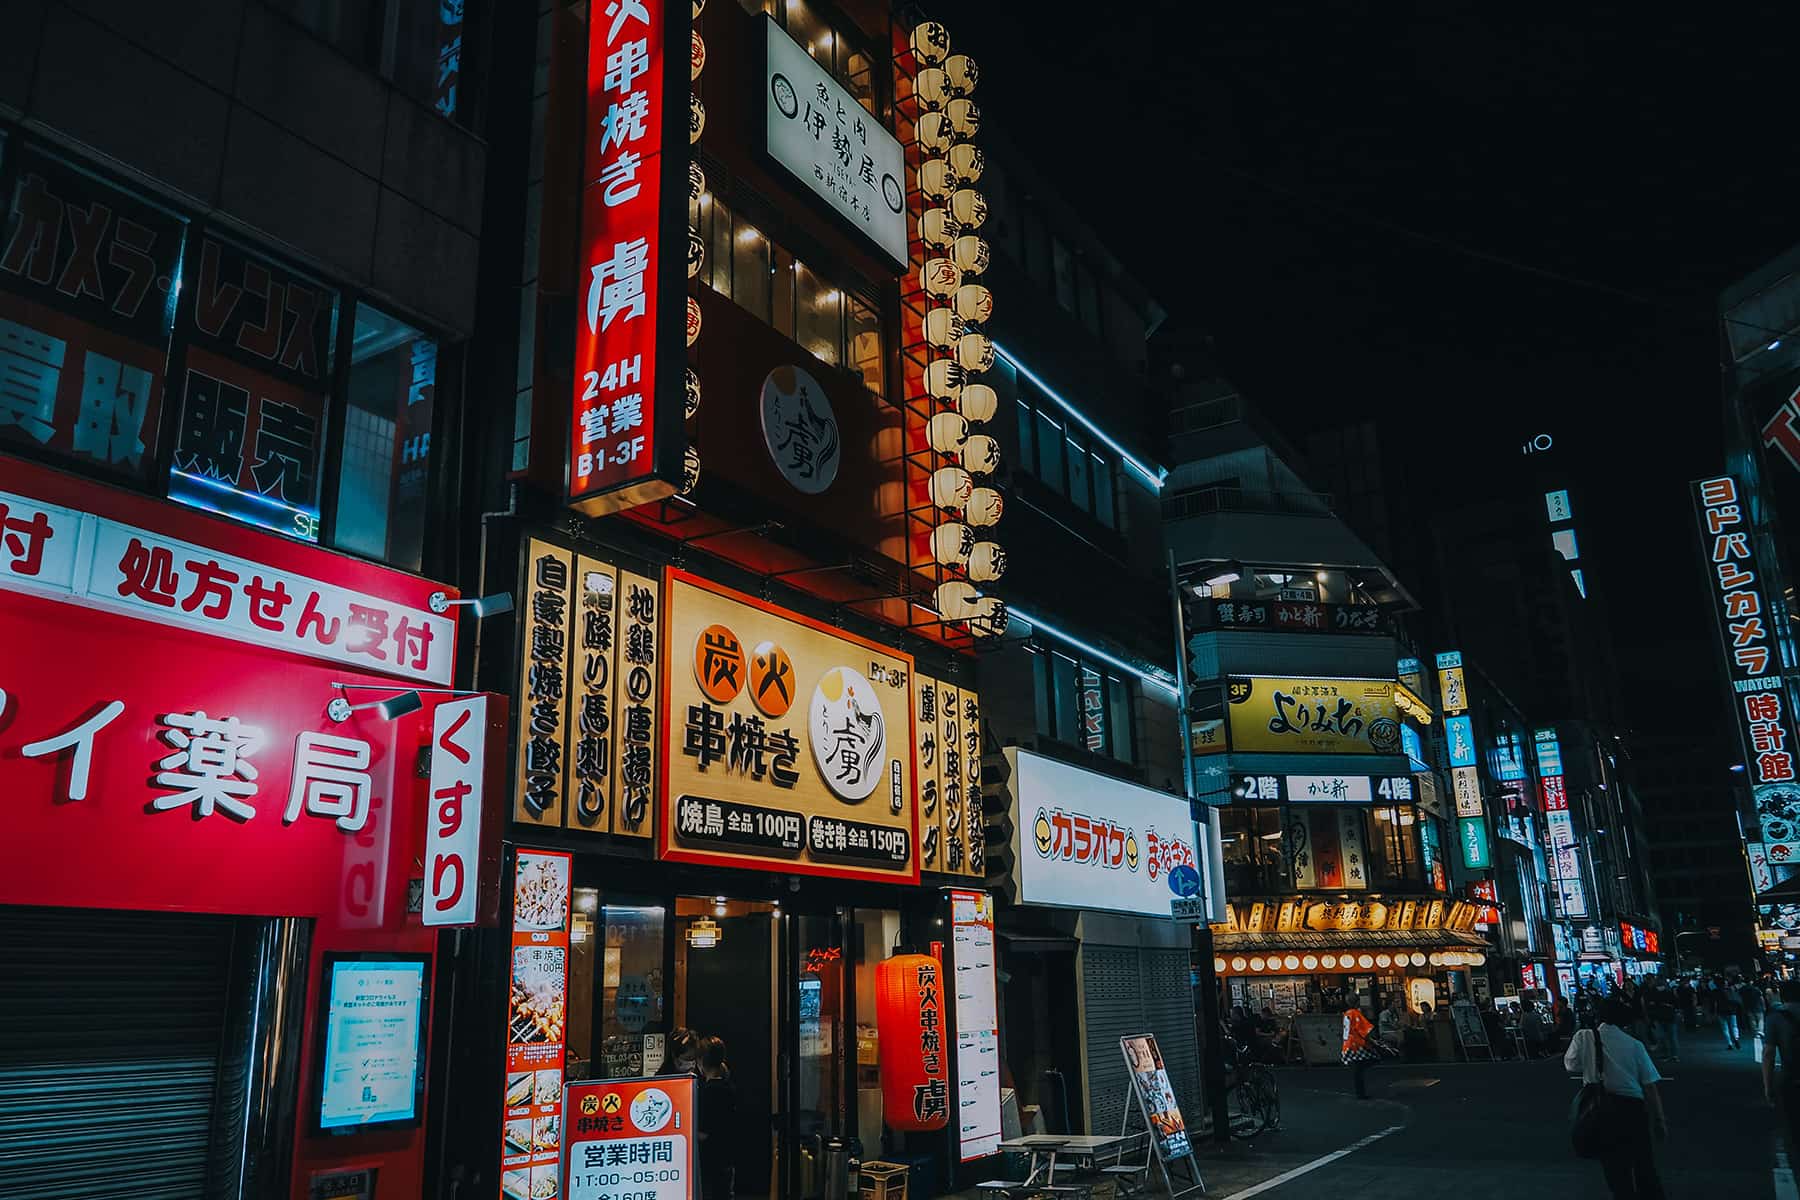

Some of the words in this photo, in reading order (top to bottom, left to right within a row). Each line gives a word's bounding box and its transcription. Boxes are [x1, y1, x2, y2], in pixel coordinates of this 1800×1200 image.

[802, 101, 879, 193] 伊勢屋
[582, 353, 642, 402] 24H
[174, 366, 320, 501] 販売
[579, 393, 643, 446] 営業
[577, 439, 646, 479] B1-3F
[1700, 476, 1769, 675] ヨドバシカメラ
[118, 538, 434, 672] 処方せん受付
[525, 554, 567, 820] 自家製焼き餃子
[704, 632, 790, 710] 炭火
[1230, 684, 1249, 697] 3F
[1733, 675, 1783, 693] WATCH
[1269, 691, 1363, 737] よりみち
[1744, 692, 1794, 783] 時計館
[0, 687, 371, 832] イ薬局
[683, 702, 800, 789] 串焼き
[919, 683, 941, 867] 虜サラダ
[941, 690, 964, 869] とり皮ポン酢
[1243, 776, 1280, 800] 2階
[1377, 777, 1413, 801] 4階
[433, 708, 473, 912] くすり
[681, 799, 724, 837] 焼鳥
[727, 811, 754, 834] 全品
[756, 812, 801, 842] 100円
[812, 819, 848, 851] 巻き串
[848, 830, 869, 848] 全品
[870, 830, 906, 856] 150円
[1050, 810, 1126, 868] カラオケ
[1753, 853, 1770, 895] ラーメ
[917, 965, 941, 1075] 炭火串焼き
[577, 1116, 625, 1134] 串焼き
[582, 1094, 622, 1115] 炭火
[583, 1140, 674, 1169] 営業時間
